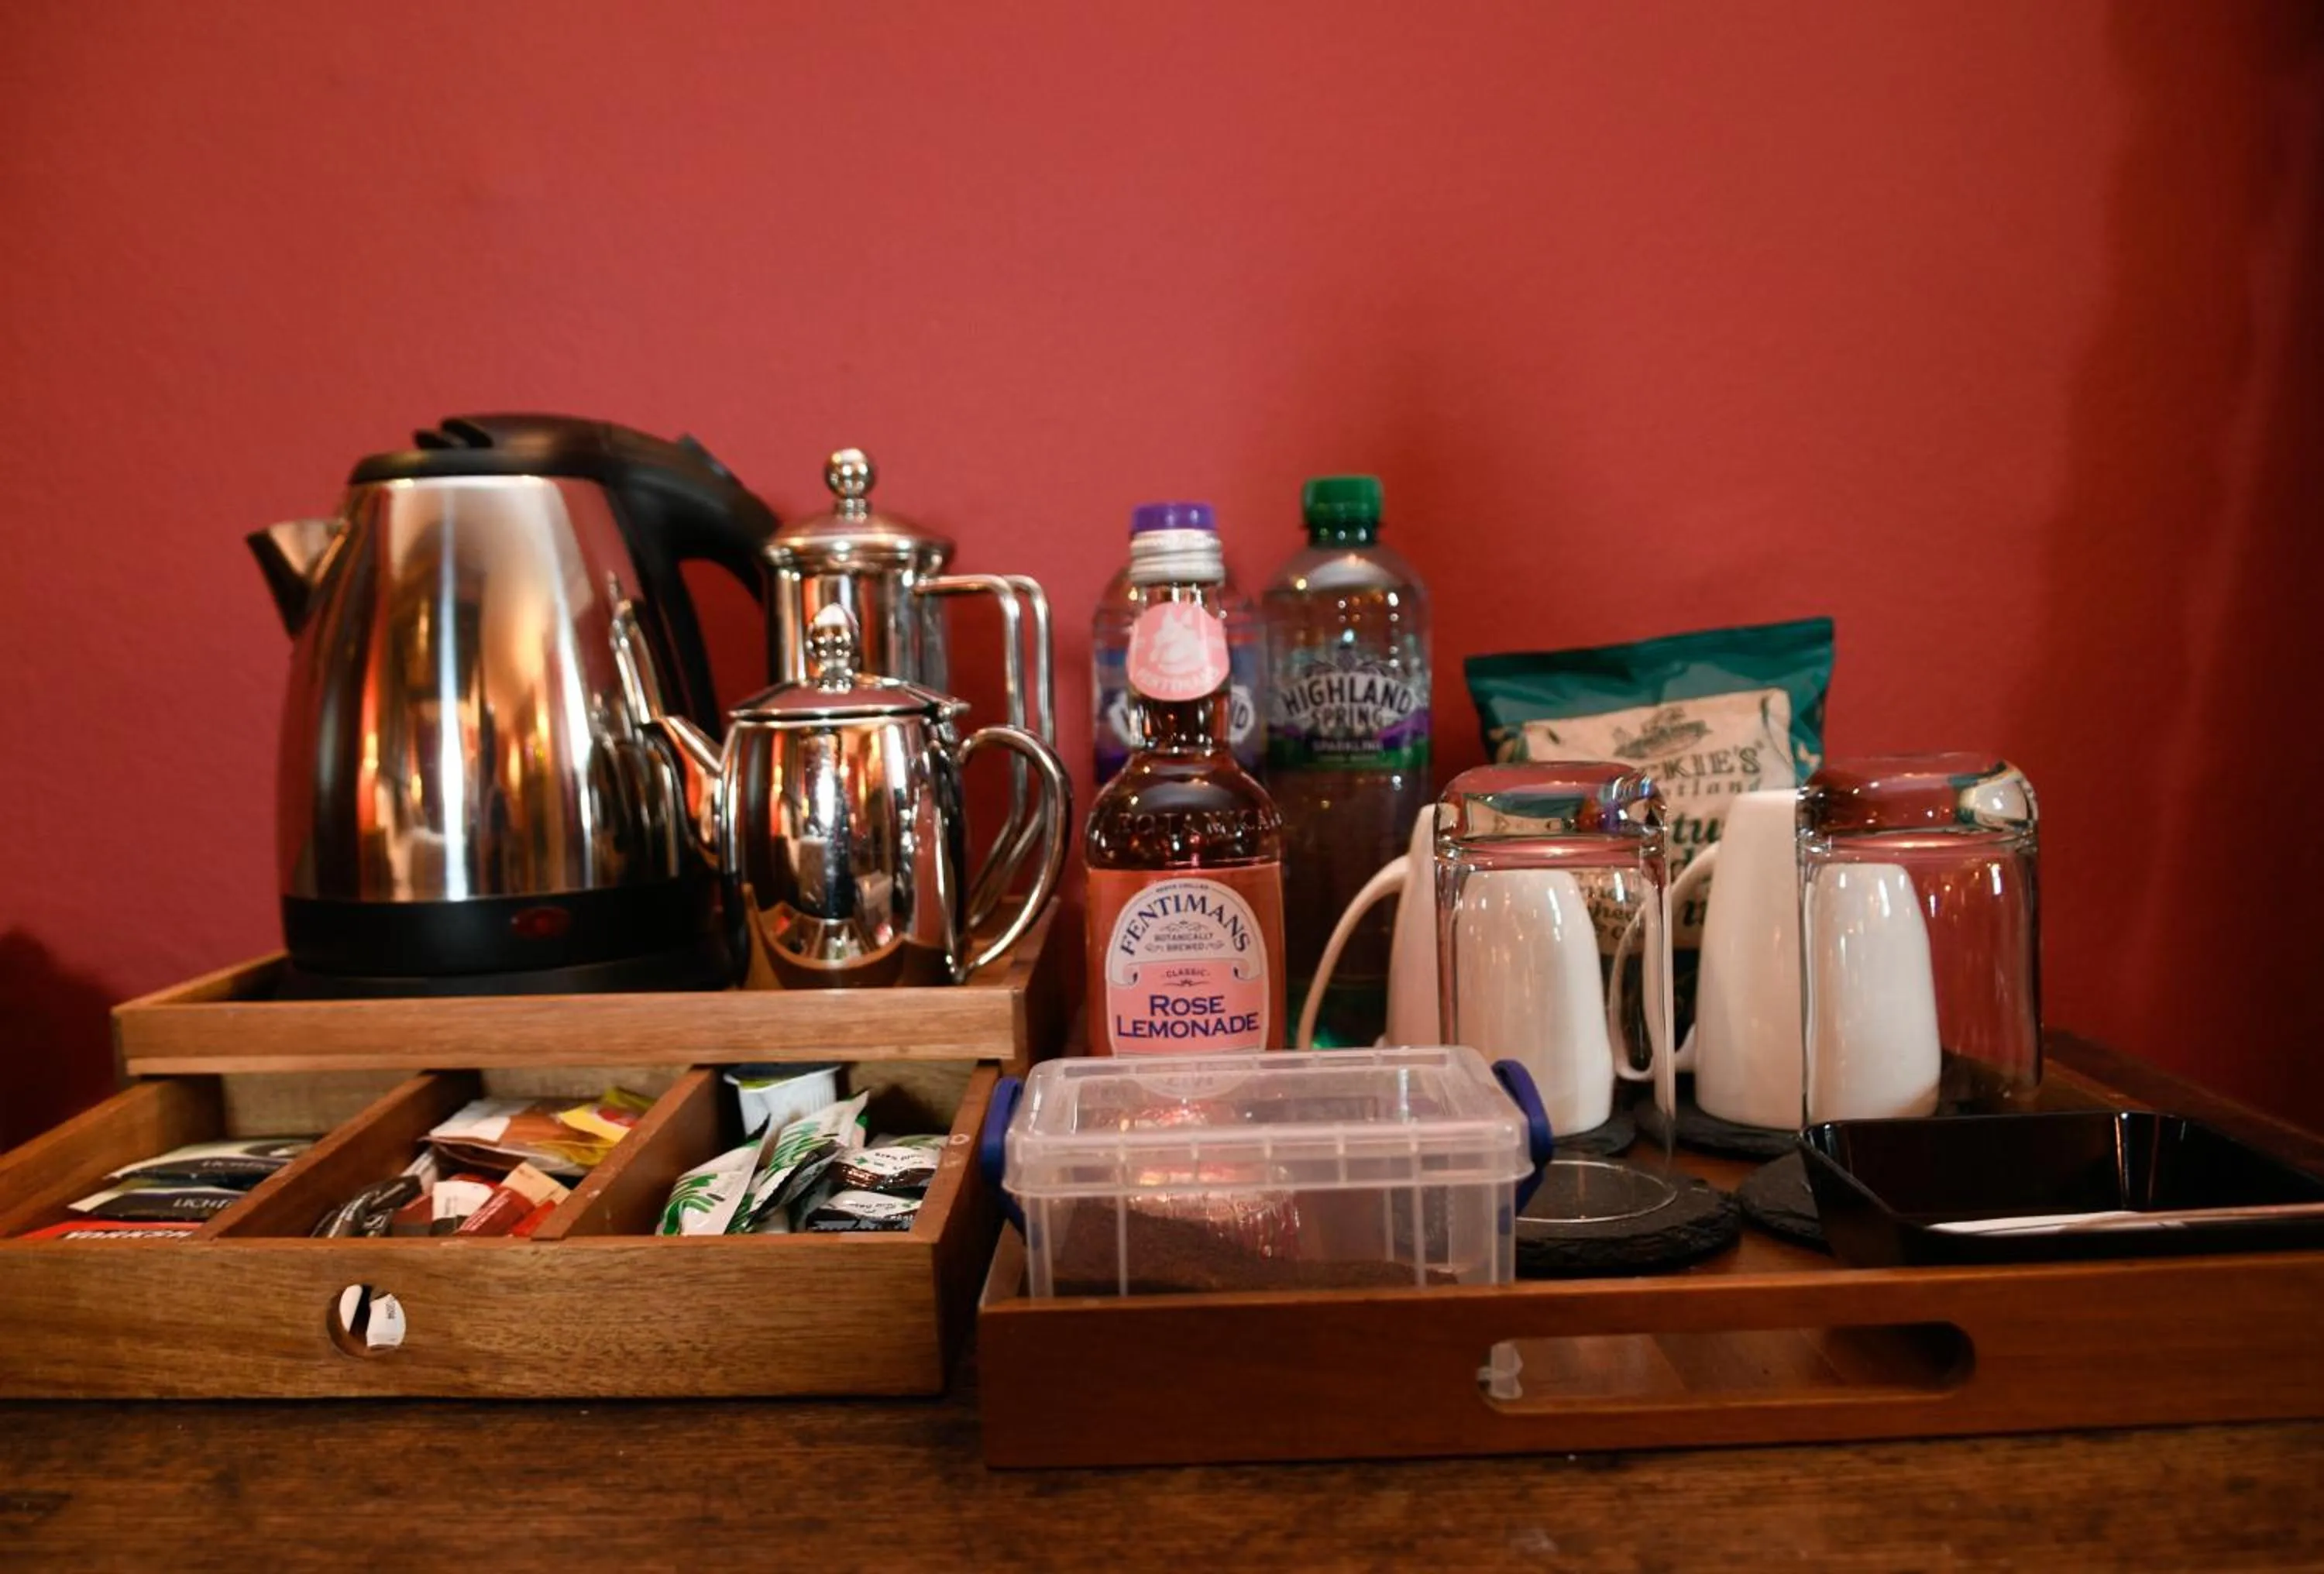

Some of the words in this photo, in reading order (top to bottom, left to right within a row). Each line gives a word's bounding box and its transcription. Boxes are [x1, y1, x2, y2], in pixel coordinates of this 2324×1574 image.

[1282, 675, 1413, 717] HIGHLAND
[1310, 706, 1384, 730] SPRING
[1635, 746, 1761, 780] KIE'S
[1120, 893, 1251, 957] FENTIMANS
[1154, 932, 1213, 942] BOTANICALLY
[1166, 942, 1205, 952] BREWED
[1149, 995, 1226, 1017] ROSE
[1116, 1012, 1260, 1039] LEMONADE
